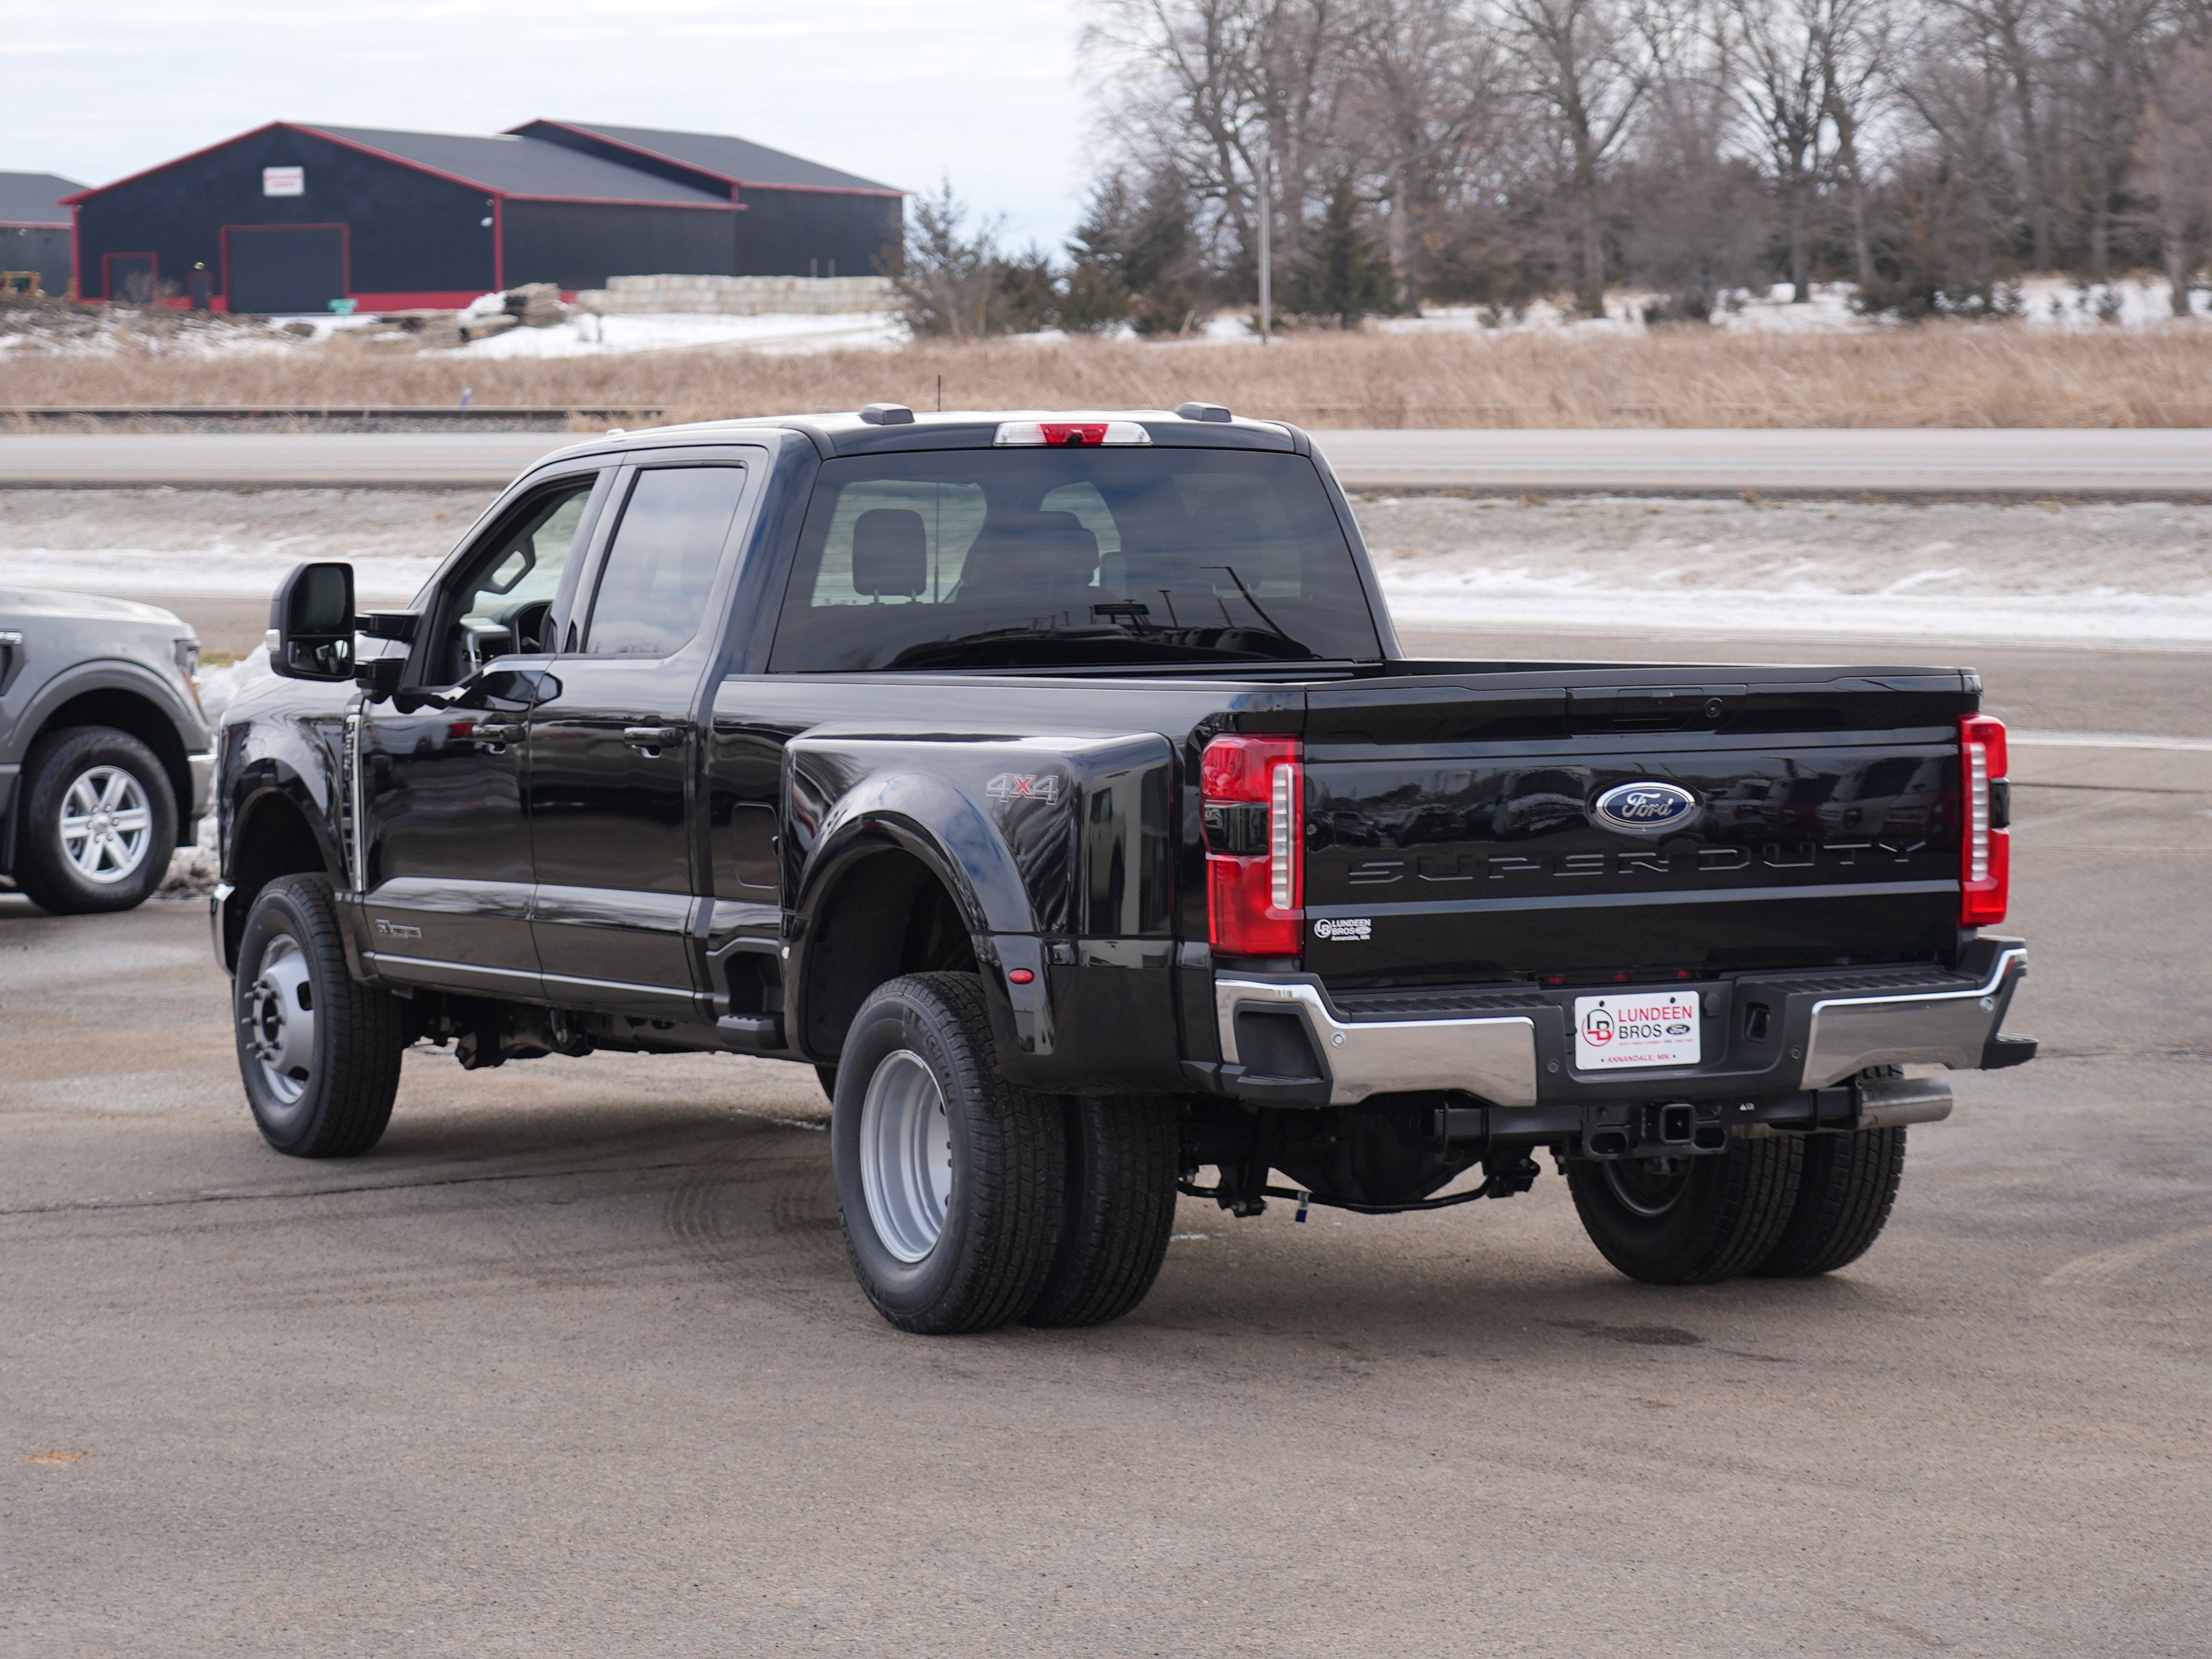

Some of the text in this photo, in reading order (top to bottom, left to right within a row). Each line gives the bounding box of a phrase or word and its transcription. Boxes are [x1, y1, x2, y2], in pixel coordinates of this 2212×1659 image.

[1622, 792, 1674, 818] Ford
[1349, 841, 1926, 884] SUPER DUTY
[1331, 919, 1372, 928] LUNDEEN
[1332, 926, 1355, 935] BROS
[1618, 1006, 1693, 1022] LUNDEEN
[1619, 1024, 1662, 1039] BROS
[1607, 1055, 1655, 1063] ANNANDALE,
